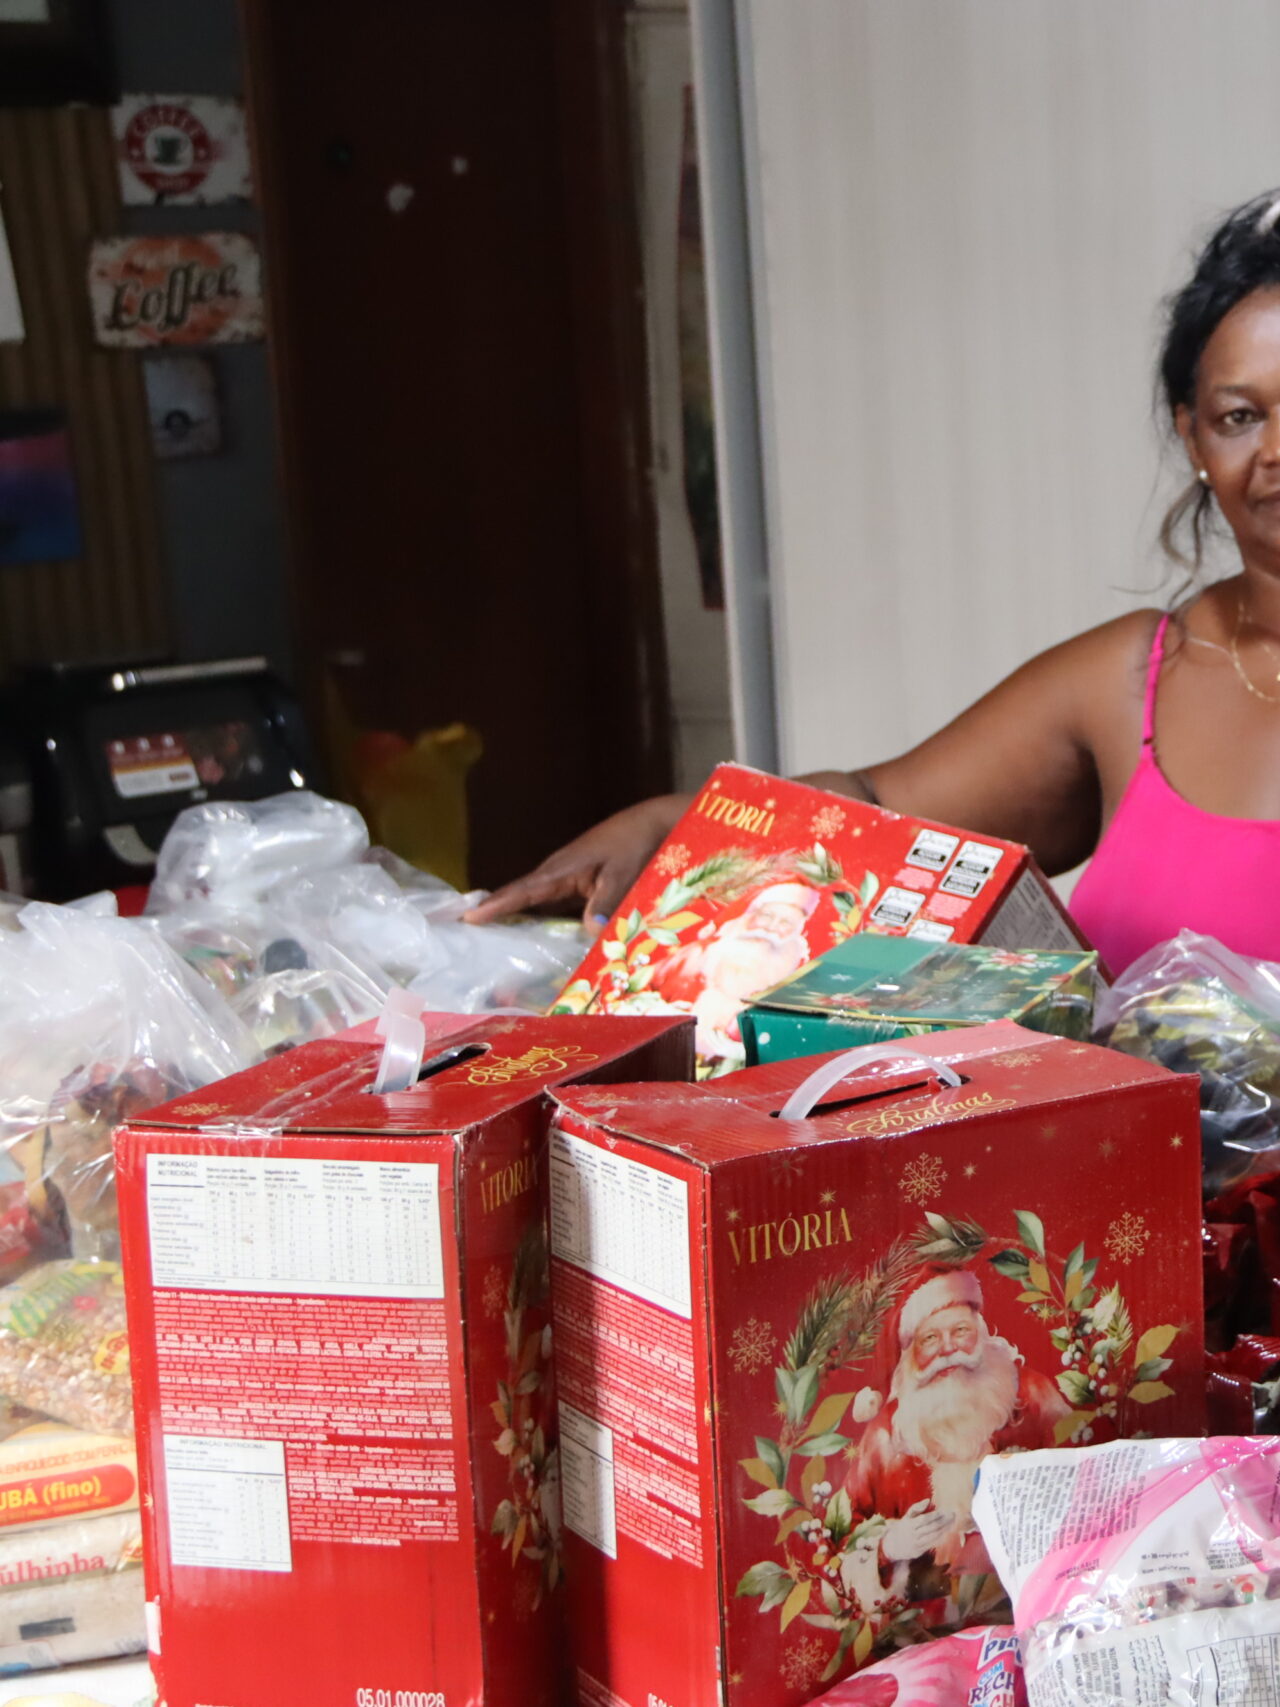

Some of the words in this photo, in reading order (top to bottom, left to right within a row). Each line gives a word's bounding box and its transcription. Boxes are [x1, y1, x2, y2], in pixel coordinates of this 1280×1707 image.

[697, 792, 776, 837] VITÓRIA
[728, 1207, 853, 1267] VITÓRIA
[43, 1475, 102, 1505] (fino)
